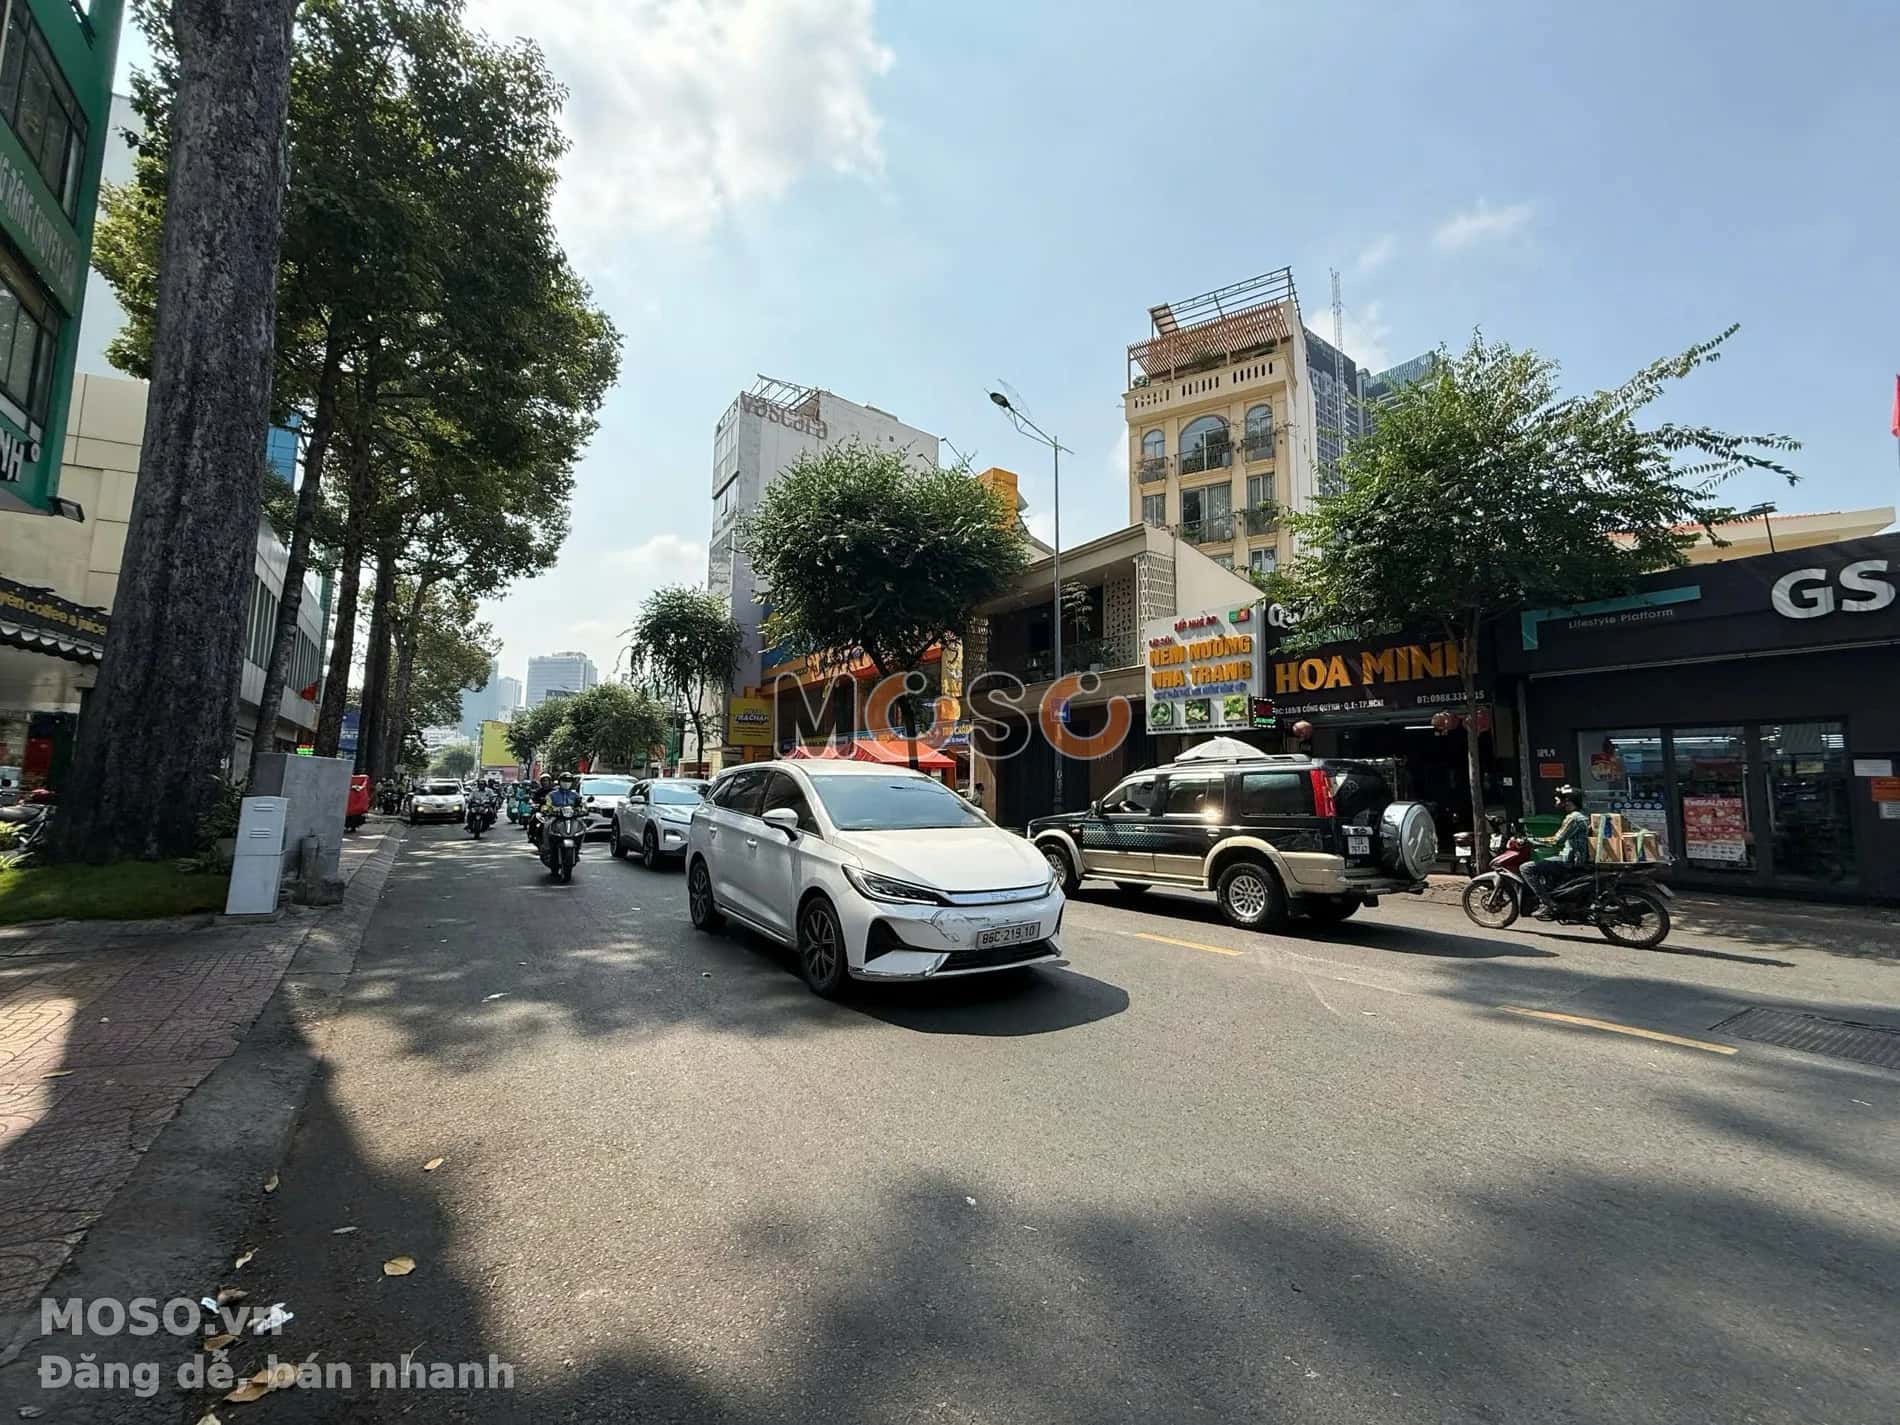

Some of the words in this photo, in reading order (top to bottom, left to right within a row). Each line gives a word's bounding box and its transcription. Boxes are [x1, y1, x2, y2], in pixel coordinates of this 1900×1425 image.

[1770, 559, 1897, 619] GS
[25, 601, 68, 623] coffee
[1568, 615, 1617, 629] Lifestyle
[1620, 608, 1674, 622] Platform
[1149, 646, 1185, 667] NEM
[1275, 655, 1351, 694] HOA
[1361, 639, 1478, 685] MINH
[1151, 669, 1186, 690] NHA
[1190, 661, 1252, 686] TRANG
